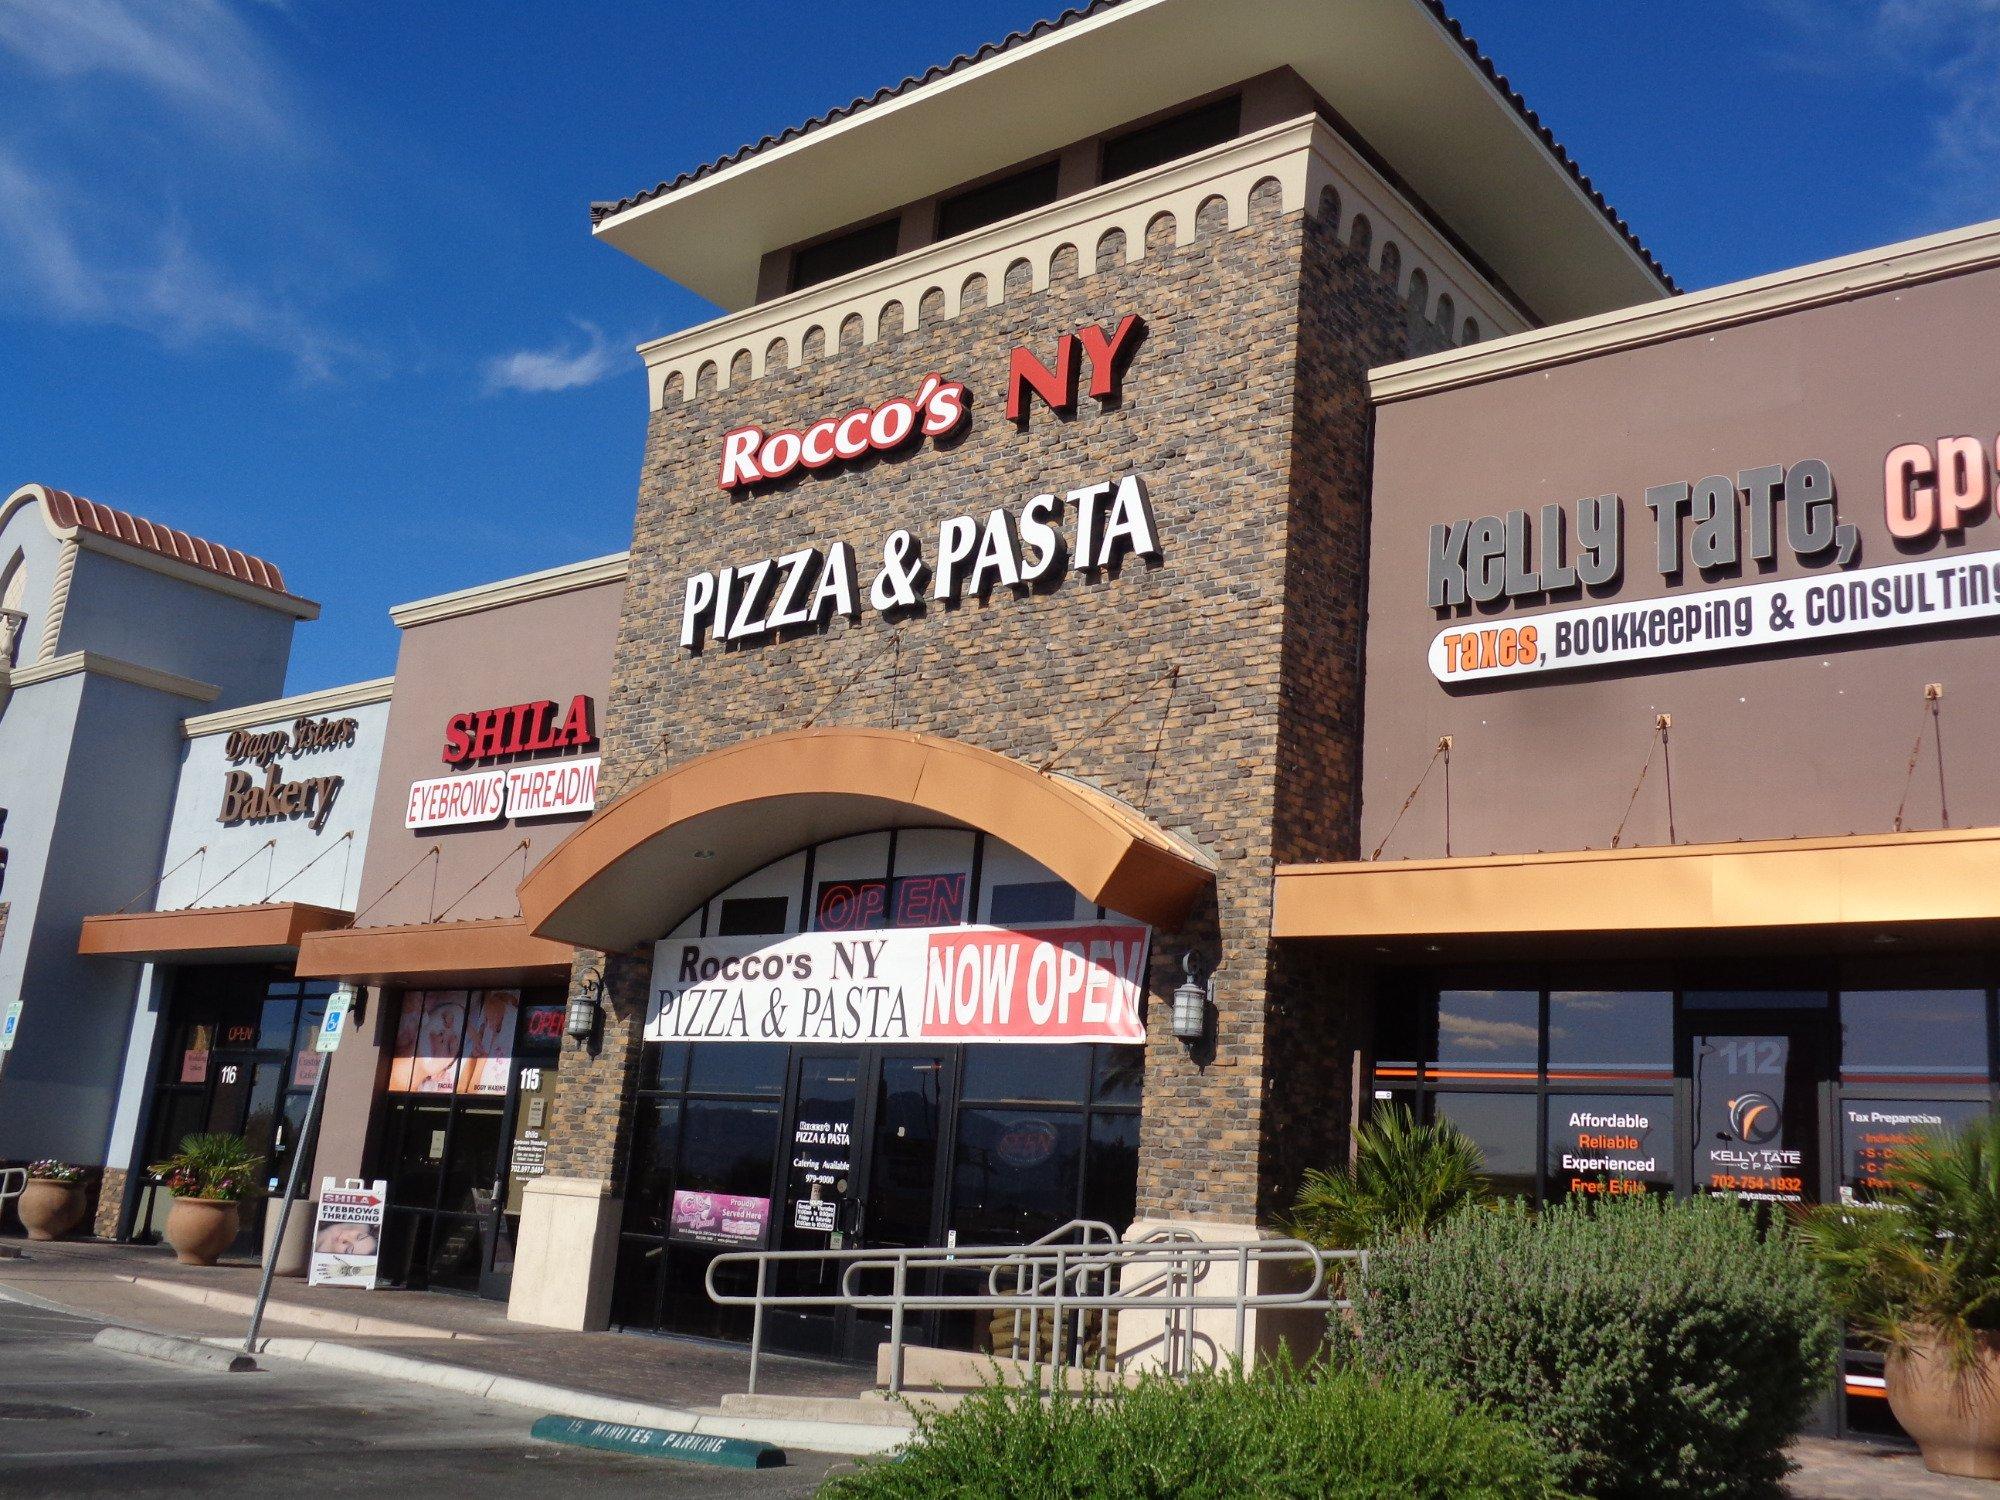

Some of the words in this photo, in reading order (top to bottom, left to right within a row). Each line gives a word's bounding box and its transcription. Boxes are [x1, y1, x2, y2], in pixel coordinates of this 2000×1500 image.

[1006, 314, 1146, 420] NY
[680, 541, 857, 648] PIZZA
[870, 529, 922, 611] &
[934, 475, 1160, 600] PASTA
[1769, 592, 1795, 633] &
[442, 695, 596, 764] SHILA
[225, 729, 290, 767] Drago
[287, 717, 359, 754] Sisters
[217, 764, 344, 831] Bakery
[408, 778, 502, 823] EYEBROWS
[820, 872, 966, 932] OPEN
[829, 940, 889, 980] NY
[924, 943, 1021, 1026] NOW
[1026, 940, 1143, 1026] OPEN
[656, 987, 750, 1037] PIZZA
[761, 986, 788, 1038] &
[797, 985, 910, 1039] PASTA
[228, 1026, 254, 1041] OPEN
[1720, 1041, 1783, 1074] 112
[221, 1065, 238, 1084] 116
[520, 1068, 540, 1091] 115
[1569, 1112, 1649, 1128] Affordable
[1848, 1111, 1869, 1123] Tax
[1871, 1112, 1942, 1125] Preparation
[834, 1122, 849, 1133] NY
[795, 1131, 818, 1144] PIZZA
[819, 1132, 826, 1144] &
[827, 1132, 850, 1146] PASTA
[1579, 1133, 1639, 1149] Reliable
[793, 1158, 820, 1171] Catering
[822, 1160, 850, 1170] Available
[1563, 1154, 1655, 1173] Experienced
[1711, 1151, 1758, 1162] KELLY
[1761, 1152, 1801, 1164] TATE
[1740, 1162, 1773, 1171] CPA
[805, 1174, 835, 1185] 979-9000
[1711, 1174, 1802, 1191] 702-754-1932
[323, 1193, 370, 1204] SHILA
[730, 1198, 756, 1209] Proudly
[322, 1213, 379, 1222] THREADING
[323, 1205, 380, 1215] EYEBROWS
[722, 1208, 744, 1218] Served
[745, 1209, 762, 1220] Here
[566, 1420, 583, 1434] 15
[590, 1422, 653, 1444] MINUTES
[662, 1432, 727, 1454] PARKING
